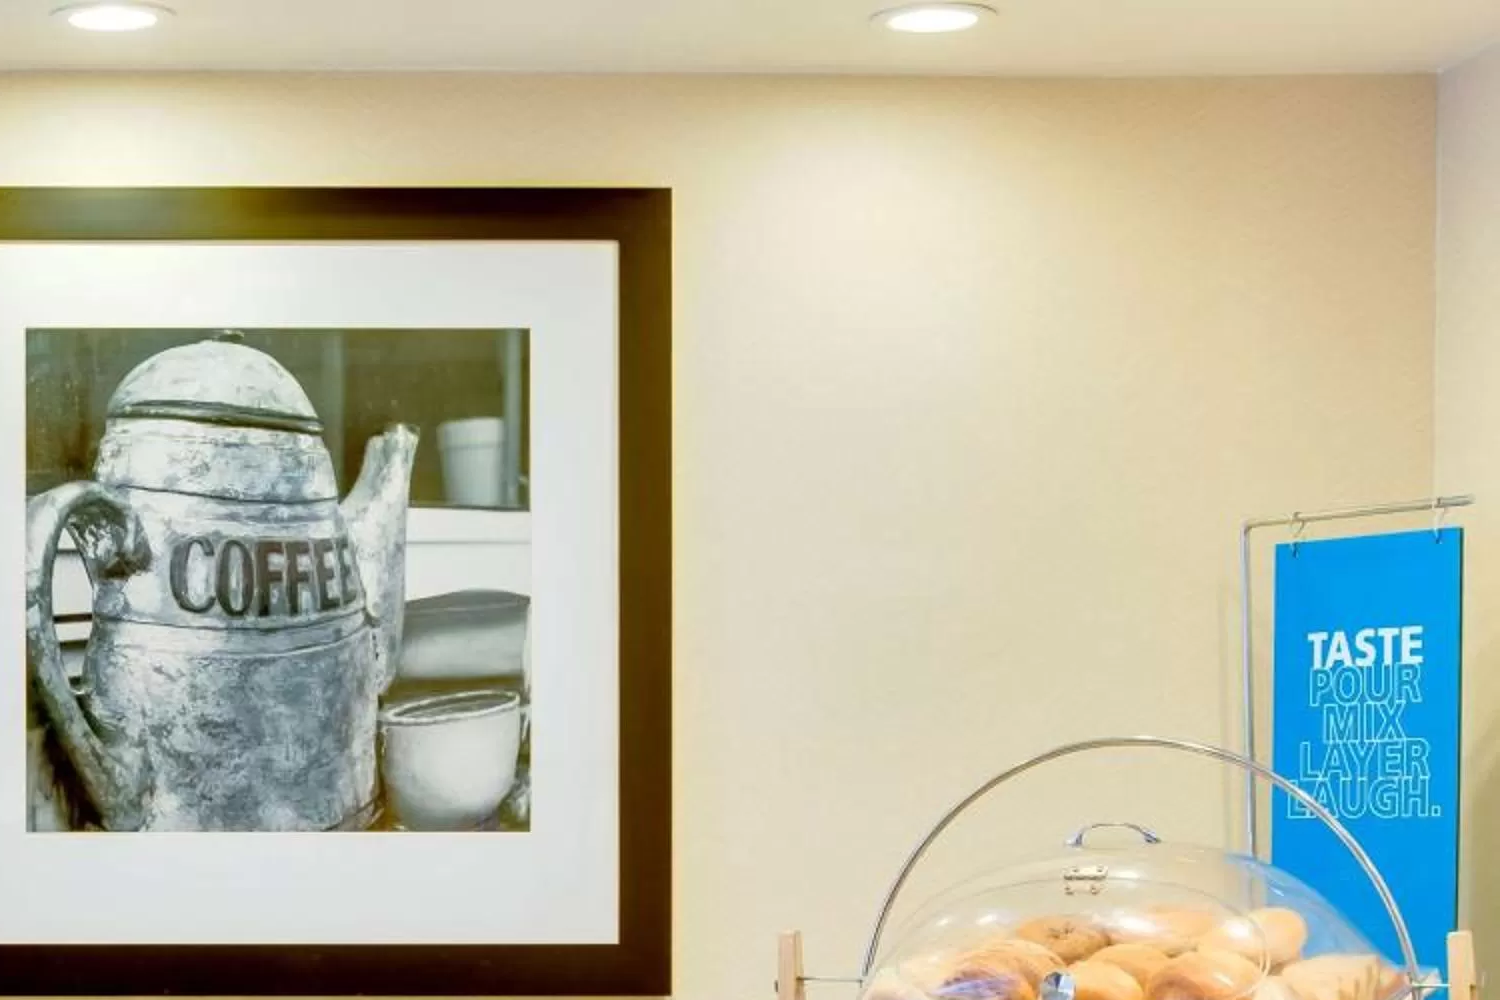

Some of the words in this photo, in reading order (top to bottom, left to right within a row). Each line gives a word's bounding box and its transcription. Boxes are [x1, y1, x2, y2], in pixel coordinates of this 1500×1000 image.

[170, 536, 358, 617] COFFEE
[1307, 625, 1424, 669] TASTE
[1309, 662, 1422, 706] POUR
[1323, 700, 1406, 744] MIX
[1300, 738, 1430, 780] LAYER
[1286, 775, 1442, 819] LAUGH.
